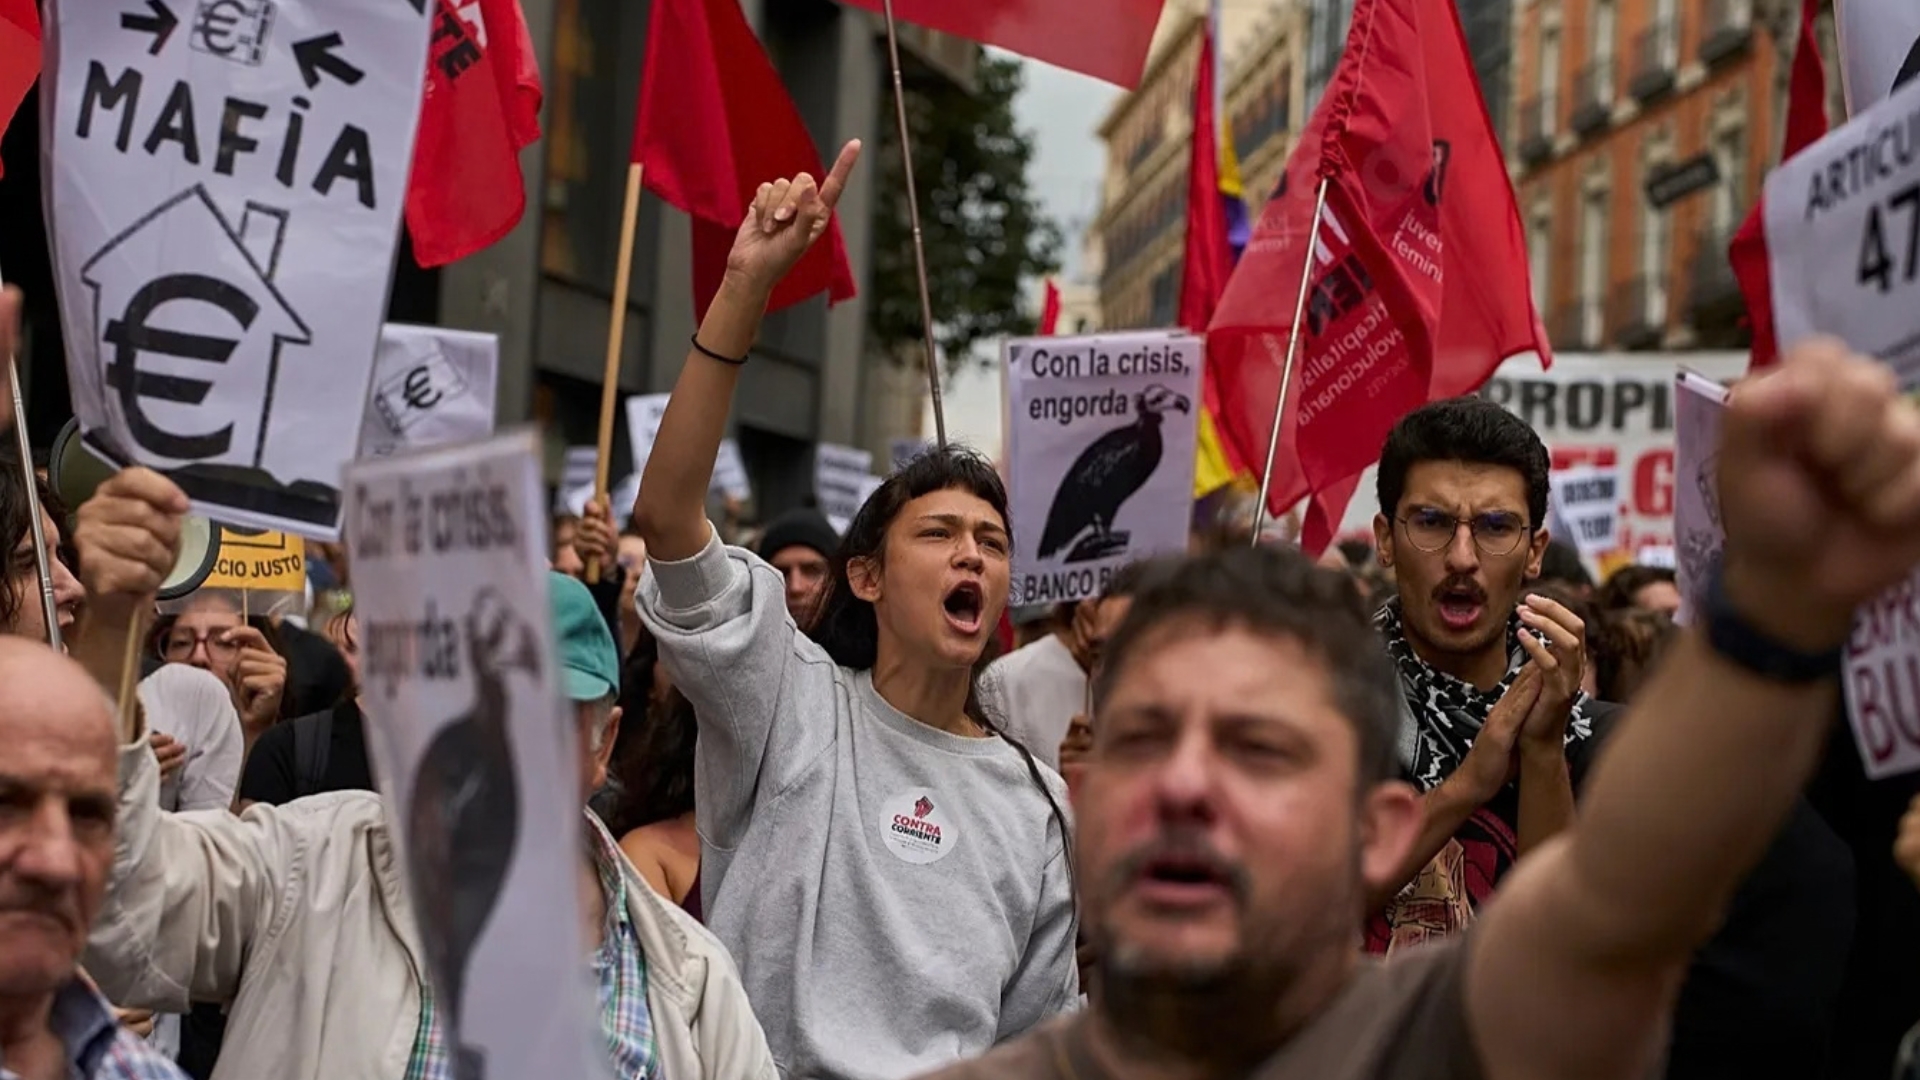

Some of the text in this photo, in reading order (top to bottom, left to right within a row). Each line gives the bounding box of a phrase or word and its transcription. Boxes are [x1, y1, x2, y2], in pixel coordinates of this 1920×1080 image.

[1857, 182, 1920, 294] 47
[1031, 345, 1190, 378] Con la crisis,
[1029, 388, 1128, 425] engorda
[213, 554, 301, 578] CIO JUSTO
[1024, 569, 1094, 602] BANCO
[892, 823, 941, 845] CORRIENTE
[893, 814, 941, 836] CONTRA
